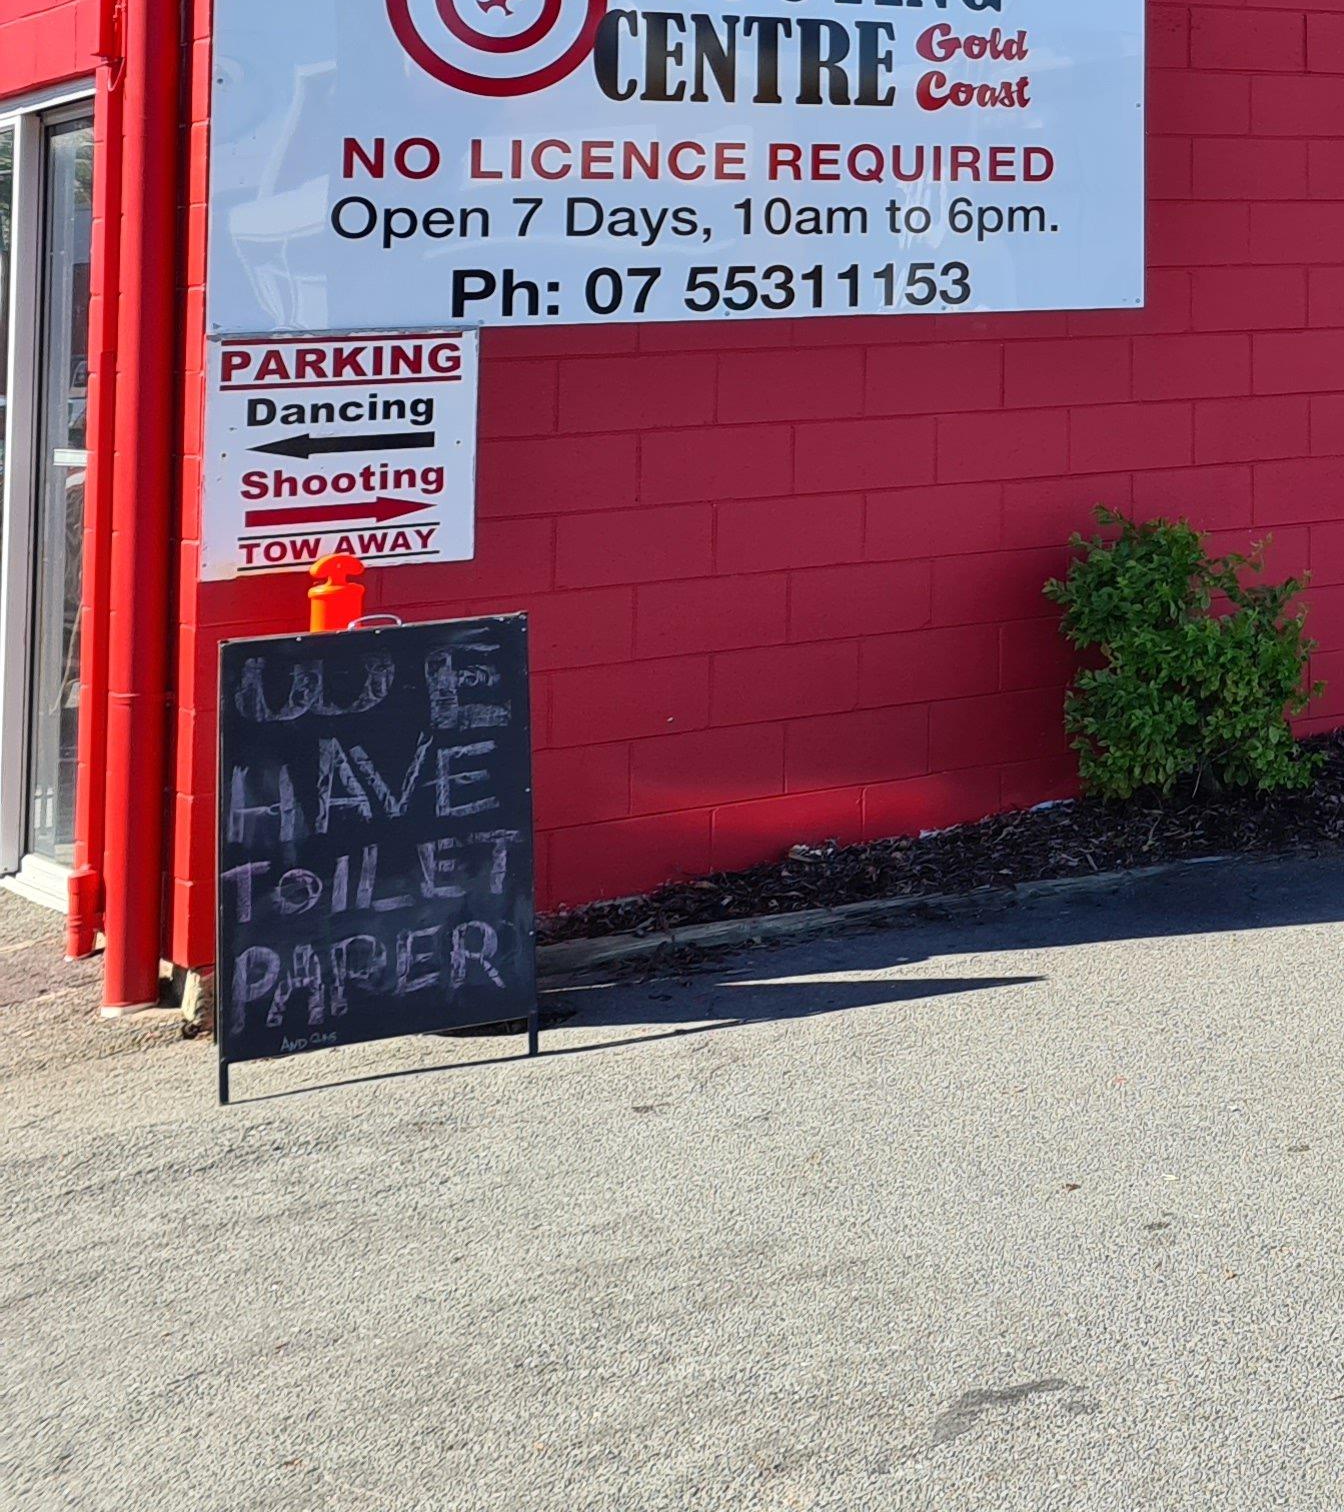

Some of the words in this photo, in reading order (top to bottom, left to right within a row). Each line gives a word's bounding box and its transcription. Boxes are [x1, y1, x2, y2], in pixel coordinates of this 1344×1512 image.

[592, 9, 896, 109] CENTRE
[915, 22, 1029, 64] Gold
[915, 69, 1031, 112] Coast
[341, 136, 440, 181] NO
[469, 139, 745, 181] LICENCE
[767, 142, 1054, 183] REQUIRED
[330, 196, 490, 249] Open
[513, 199, 545, 238] 7
[566, 198, 712, 248] Days,
[734, 199, 870, 235] 10am
[885, 201, 932, 235] to
[947, 201, 1060, 243] 6pm.
[450, 269, 561, 318] Ph:
[584, 267, 663, 315] 07
[683, 262, 972, 311] 55311153
[220, 343, 461, 382] PARKING
[247, 393, 434, 427] Dancing
[240, 463, 444, 500] Shooting
[239, 537, 321, 564] TOW
[333, 528, 437, 557] AWAY
[229, 731, 499, 843] HAVE
[221, 829, 521, 923] TOILET
[230, 920, 505, 1035] PAPER
